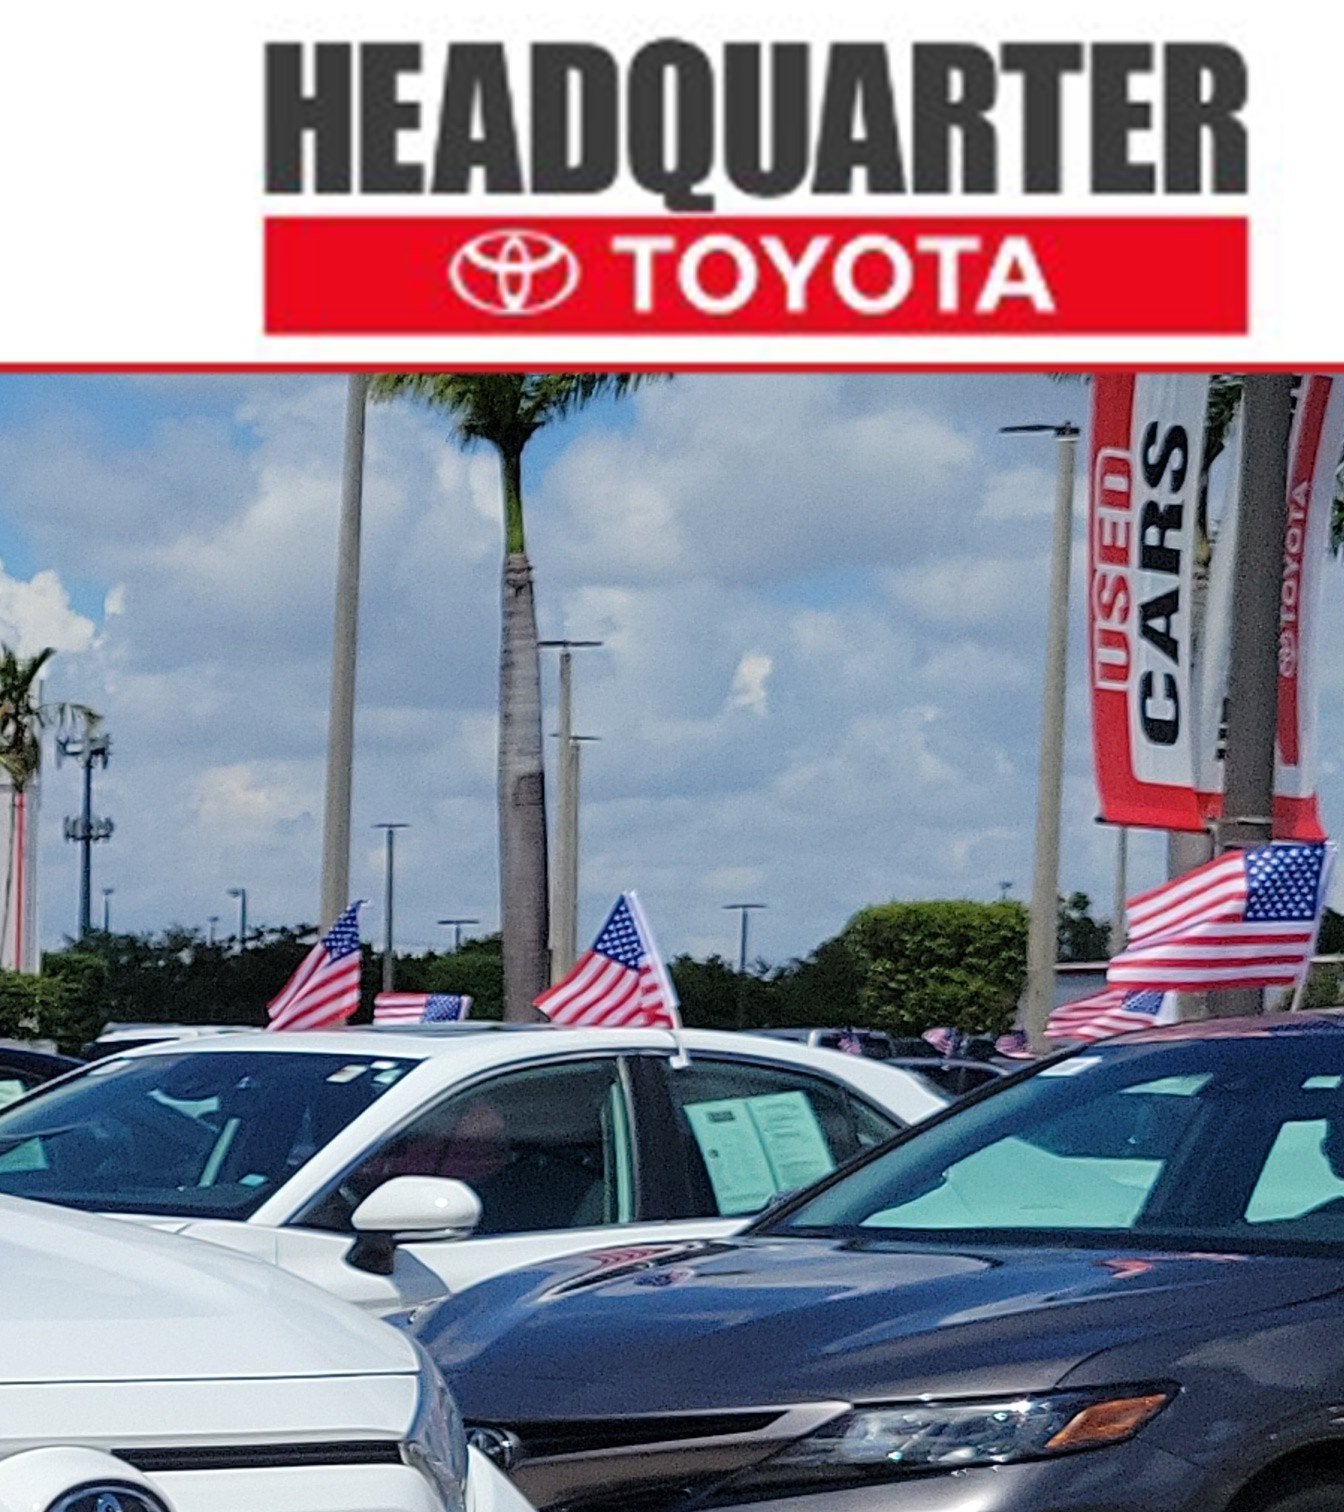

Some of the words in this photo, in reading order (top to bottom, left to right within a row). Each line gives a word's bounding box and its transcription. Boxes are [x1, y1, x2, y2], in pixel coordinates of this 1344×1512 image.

[1094, 449, 1133, 690] USED
[1139, 421, 1189, 745] CARS
[1279, 480, 1310, 628] TOYOTA
